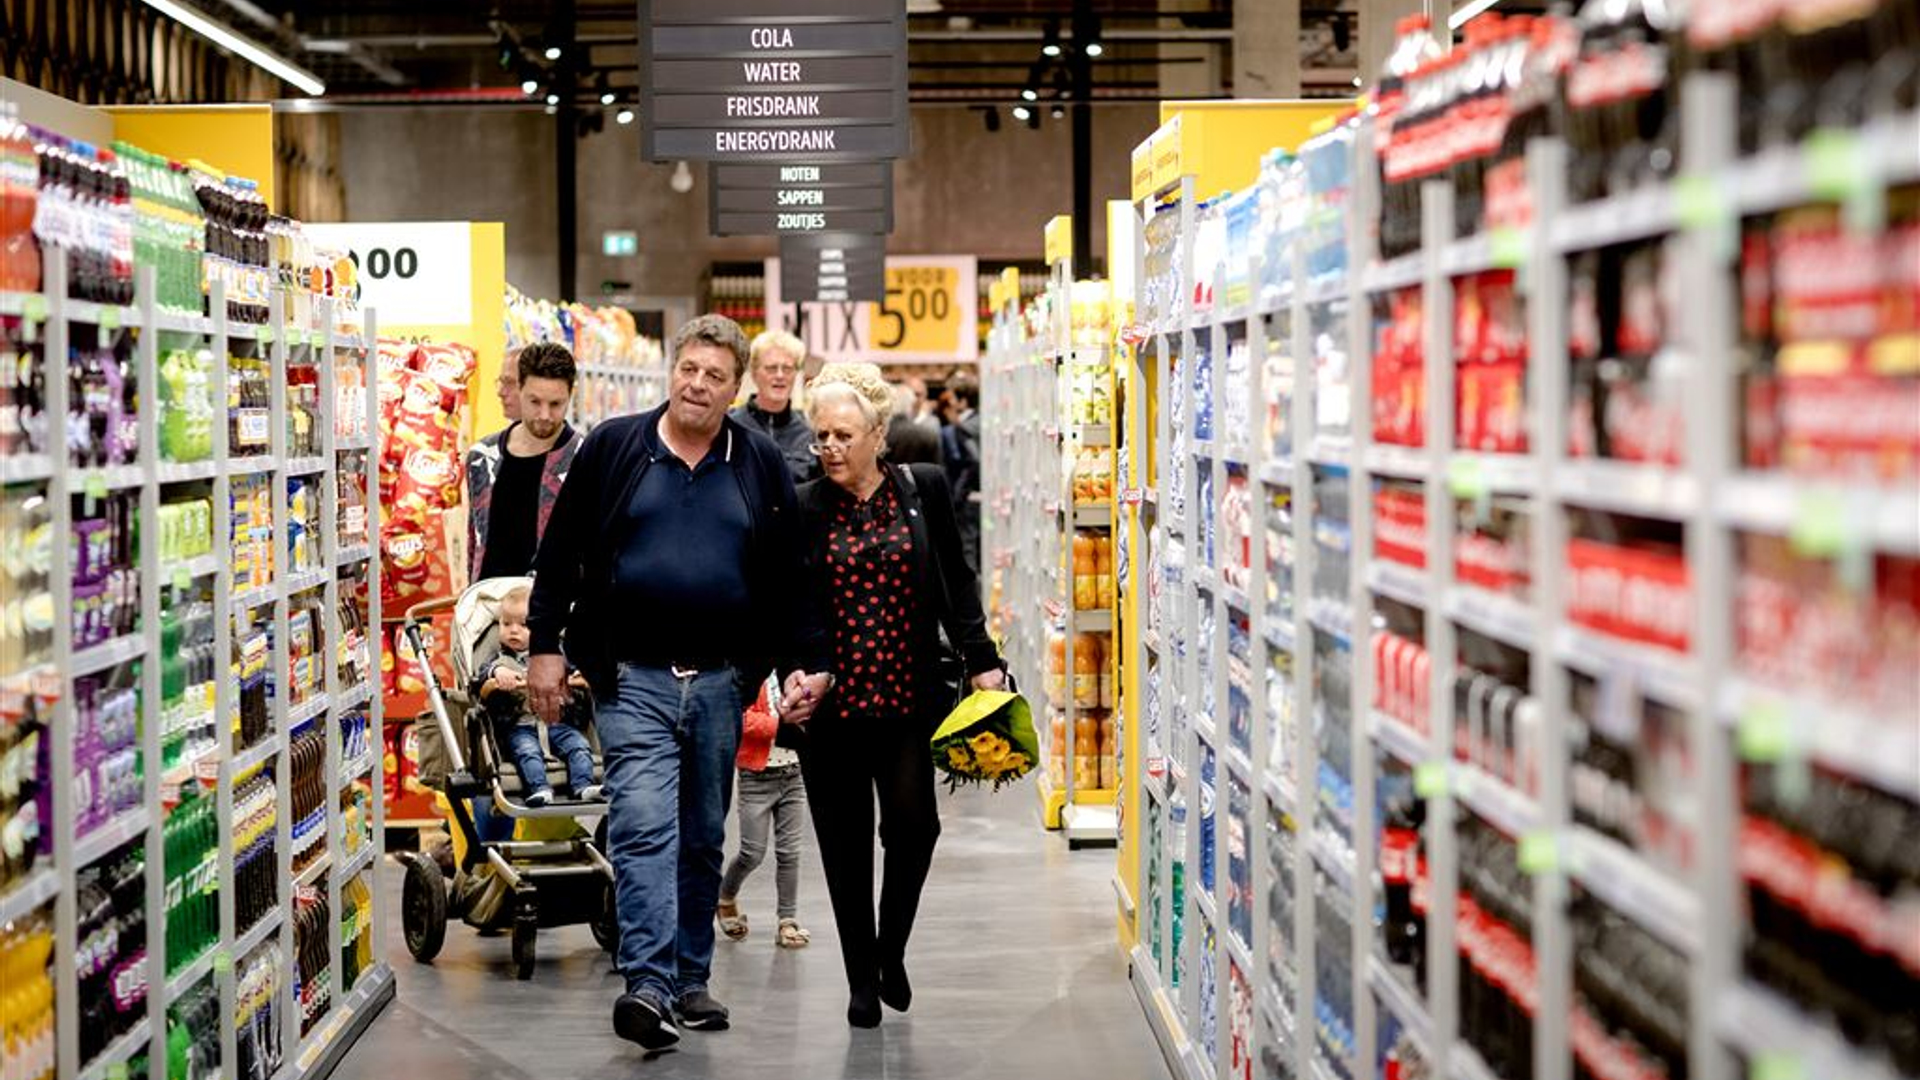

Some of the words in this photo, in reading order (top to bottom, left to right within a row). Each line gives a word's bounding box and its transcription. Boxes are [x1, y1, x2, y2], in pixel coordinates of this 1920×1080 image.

[750, 28, 793, 49] COLA
[744, 62, 801, 83] WATER
[727, 96, 820, 117] FRISDRANK
[715, 130, 836, 152] ENERGYDRANK
[780, 167, 820, 182] NOTEN
[777, 190, 824, 206] SAPPEN
[777, 213, 826, 230] ZOUTJES
